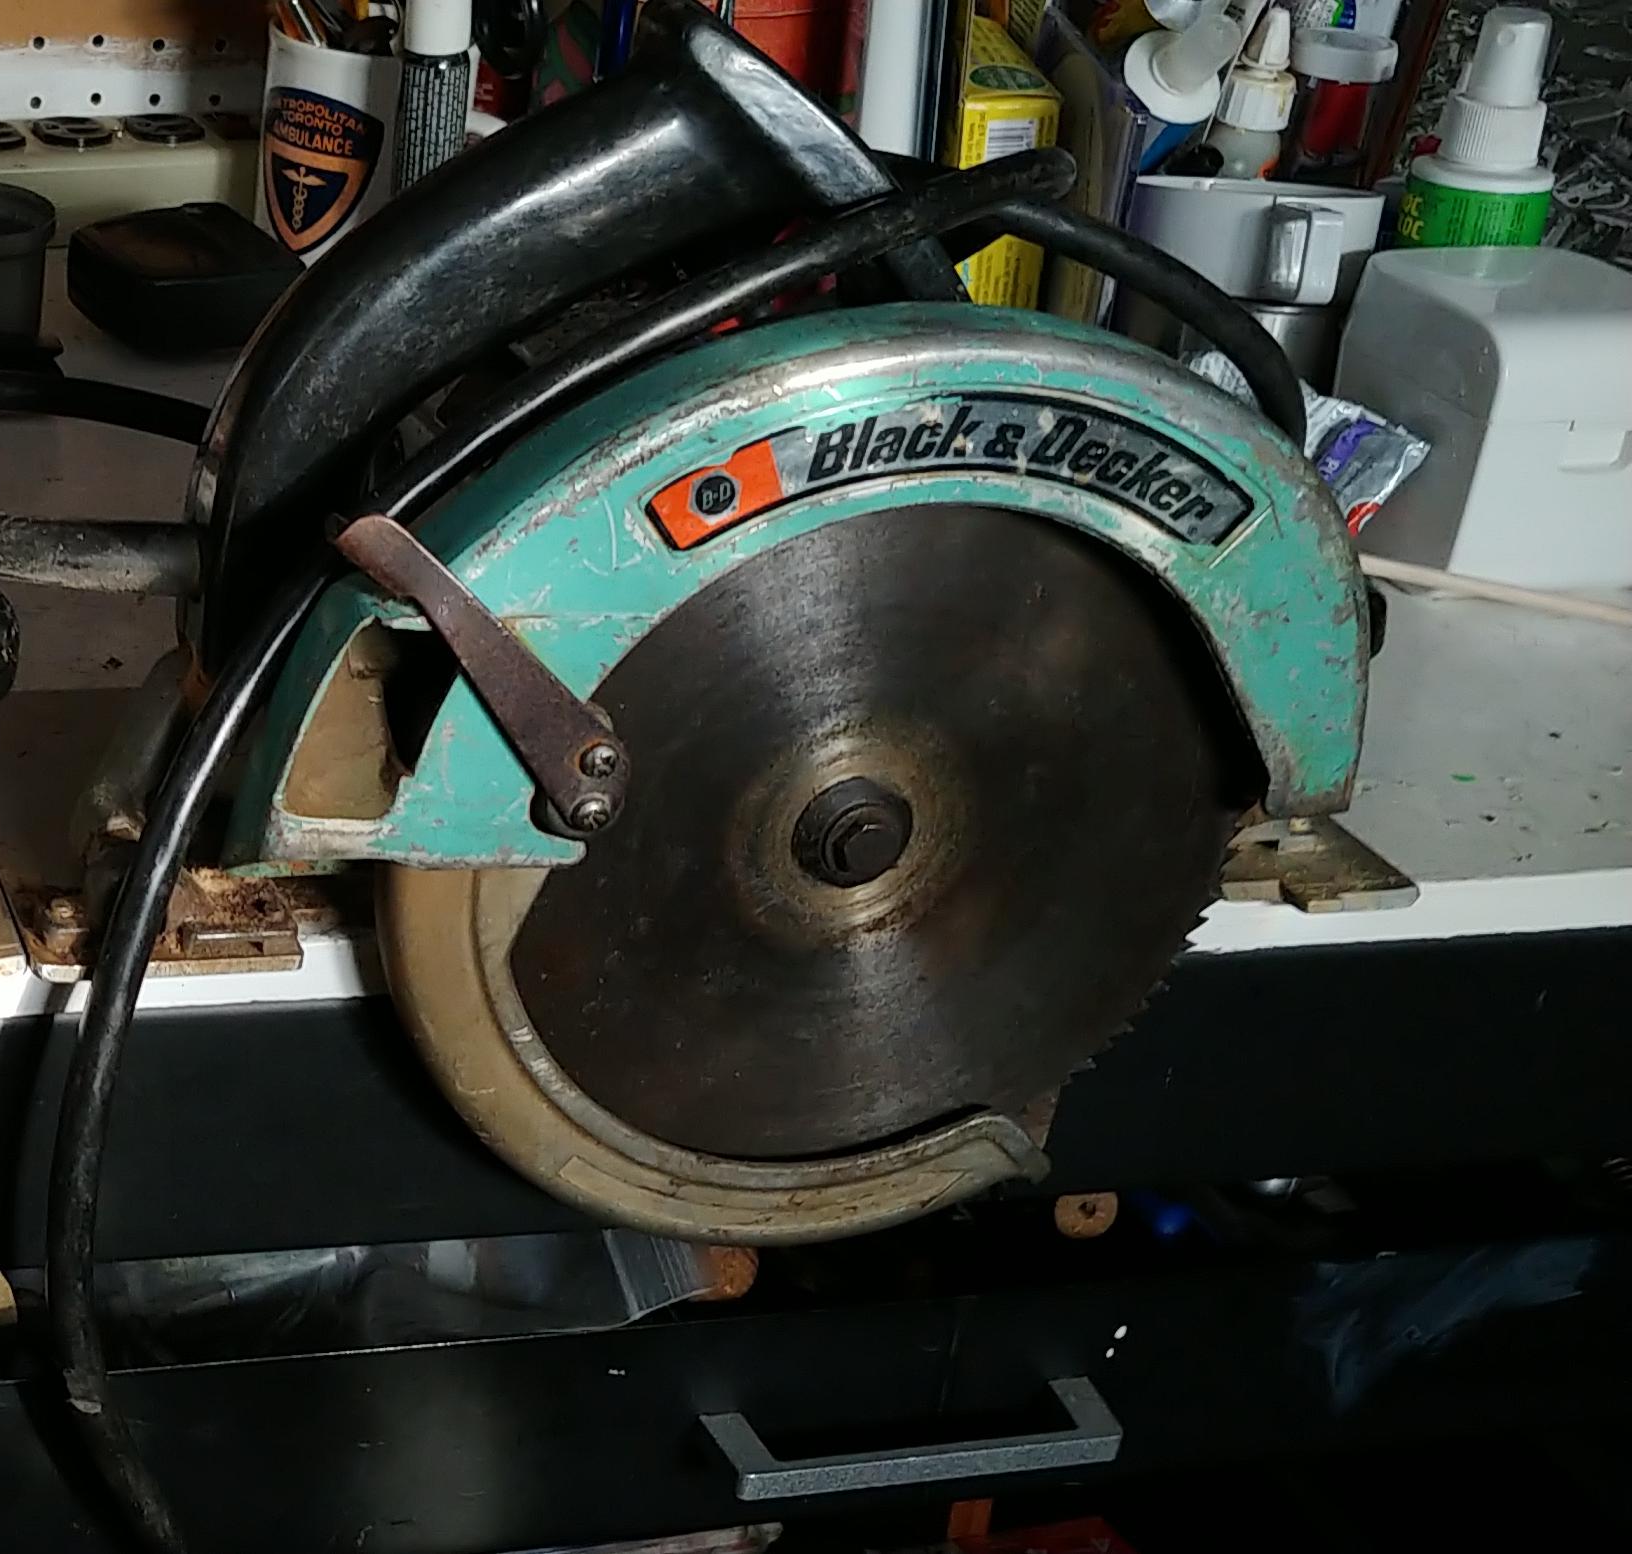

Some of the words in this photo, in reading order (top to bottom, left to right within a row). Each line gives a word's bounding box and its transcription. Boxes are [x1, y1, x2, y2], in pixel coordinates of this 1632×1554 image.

[273, 120, 353, 156] AMBULANCE
[282, 110, 343, 136] TORONTO
[807, 406, 984, 483] Black
[983, 424, 1025, 461] &
[1028, 415, 1215, 521] Decker
